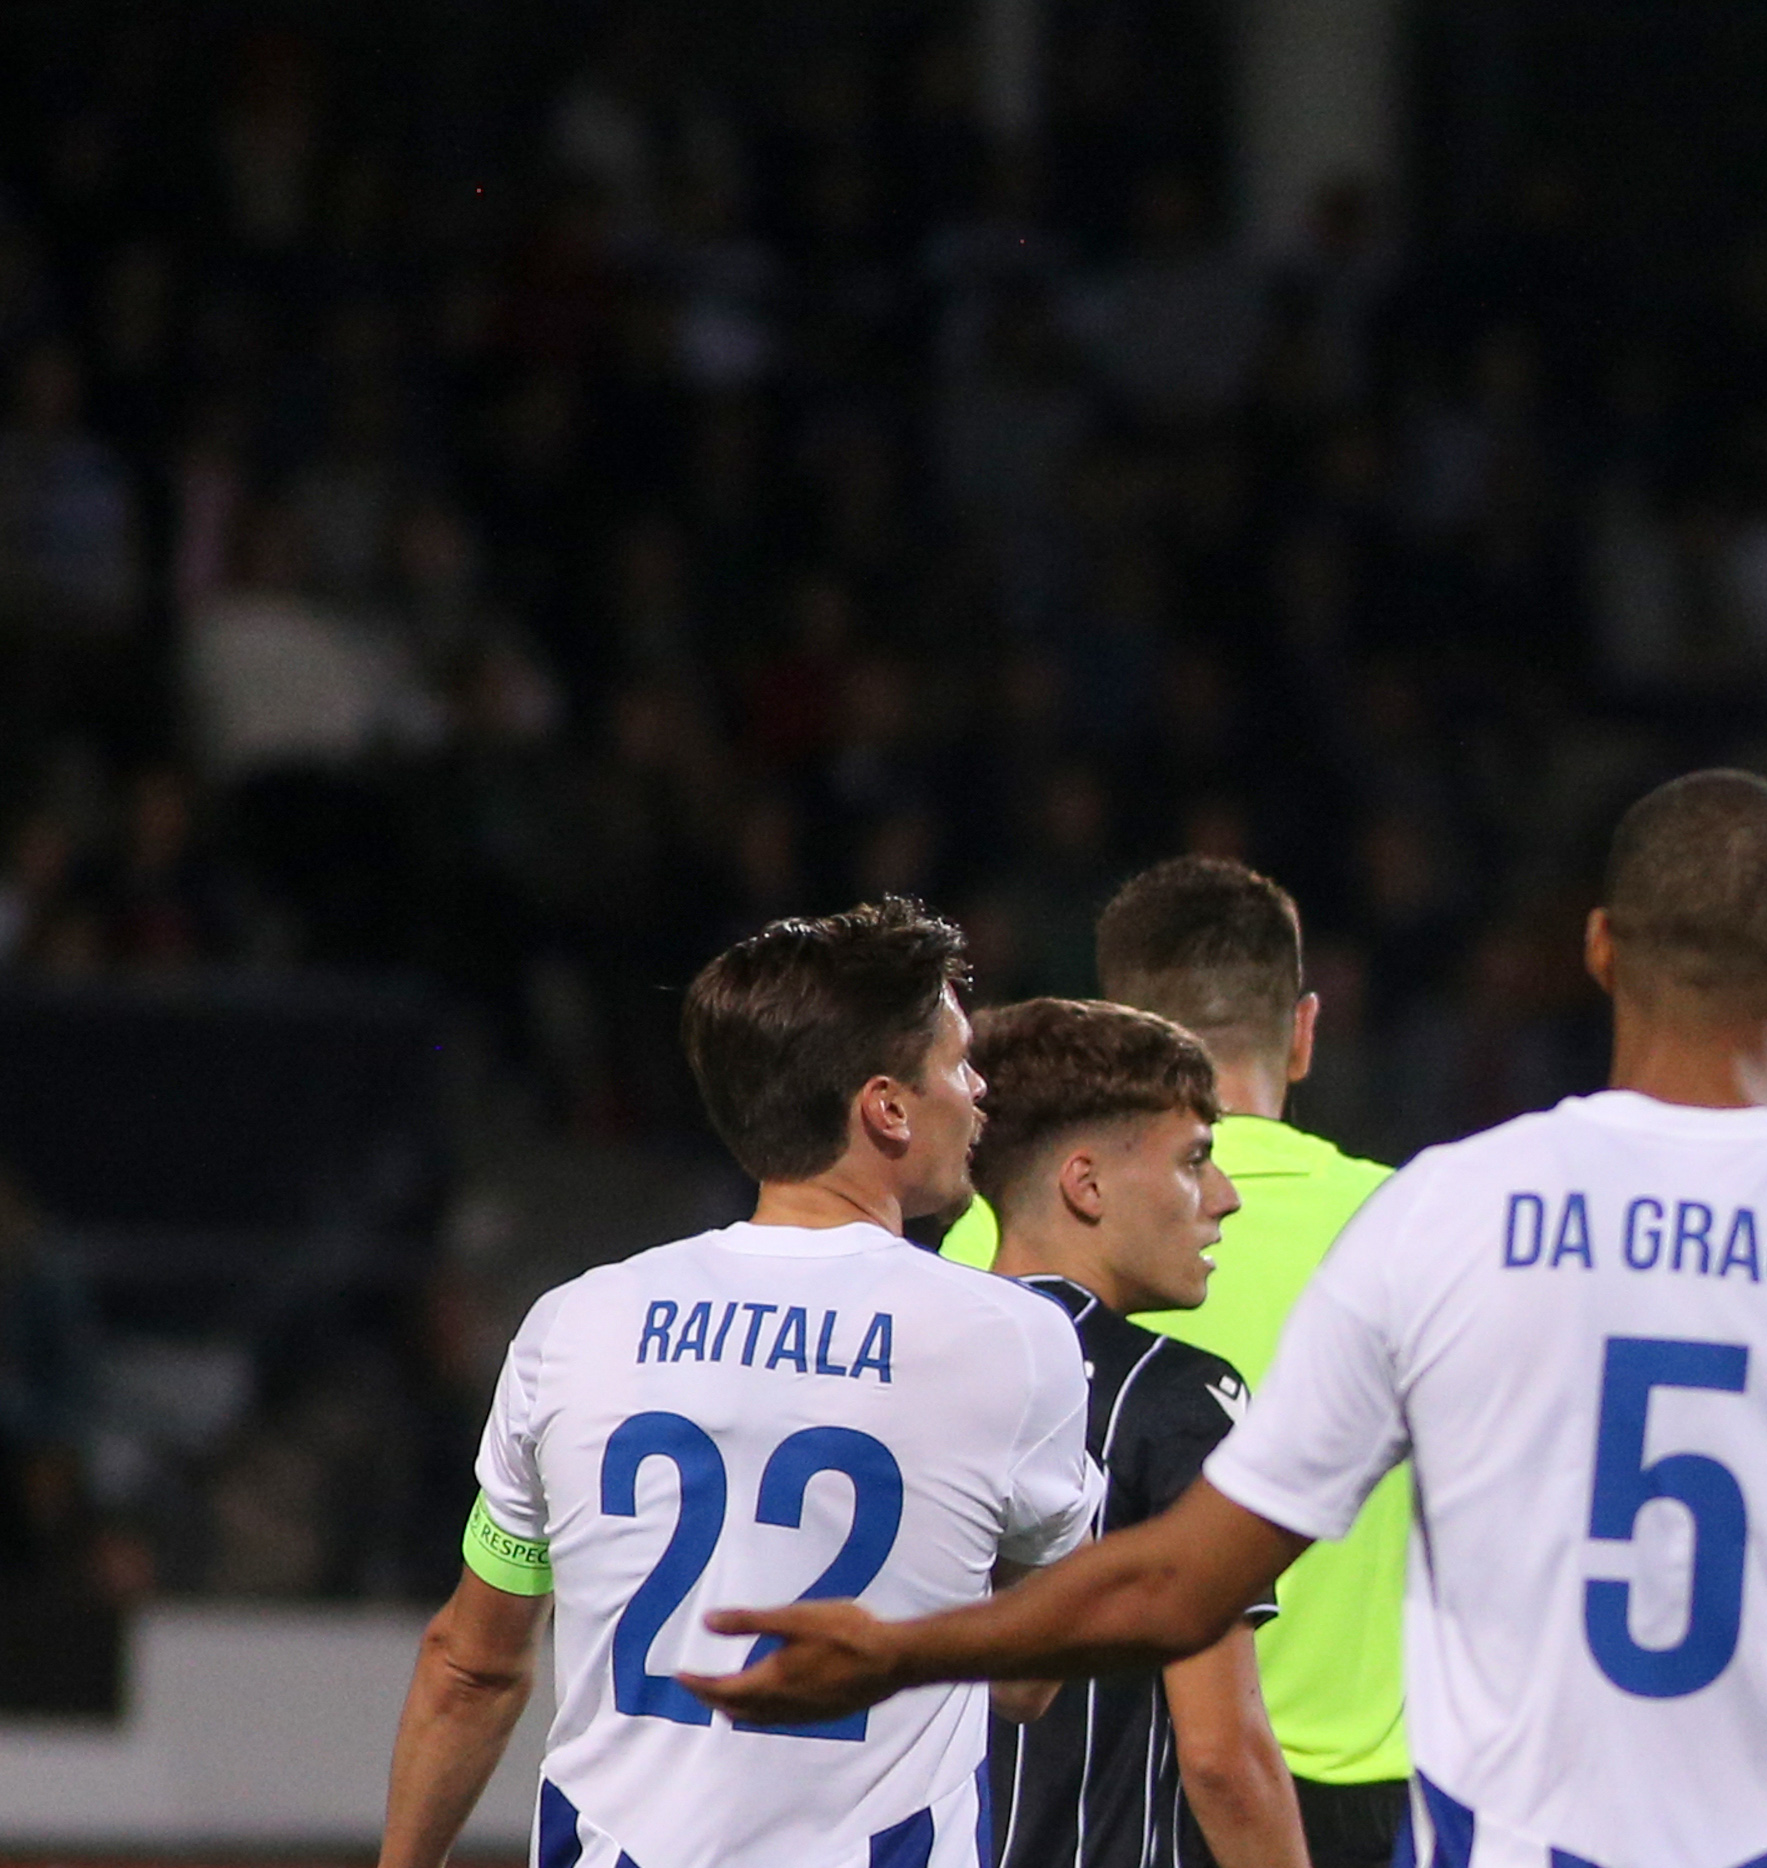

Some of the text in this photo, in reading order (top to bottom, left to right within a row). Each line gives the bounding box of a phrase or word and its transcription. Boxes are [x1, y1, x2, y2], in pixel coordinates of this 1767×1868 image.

[1501, 1193, 1594, 1270] DA
[636, 1299, 893, 1385] RAITALA
[600, 1410, 903, 1742] 22
[1583, 1335, 1750, 1699] 5
